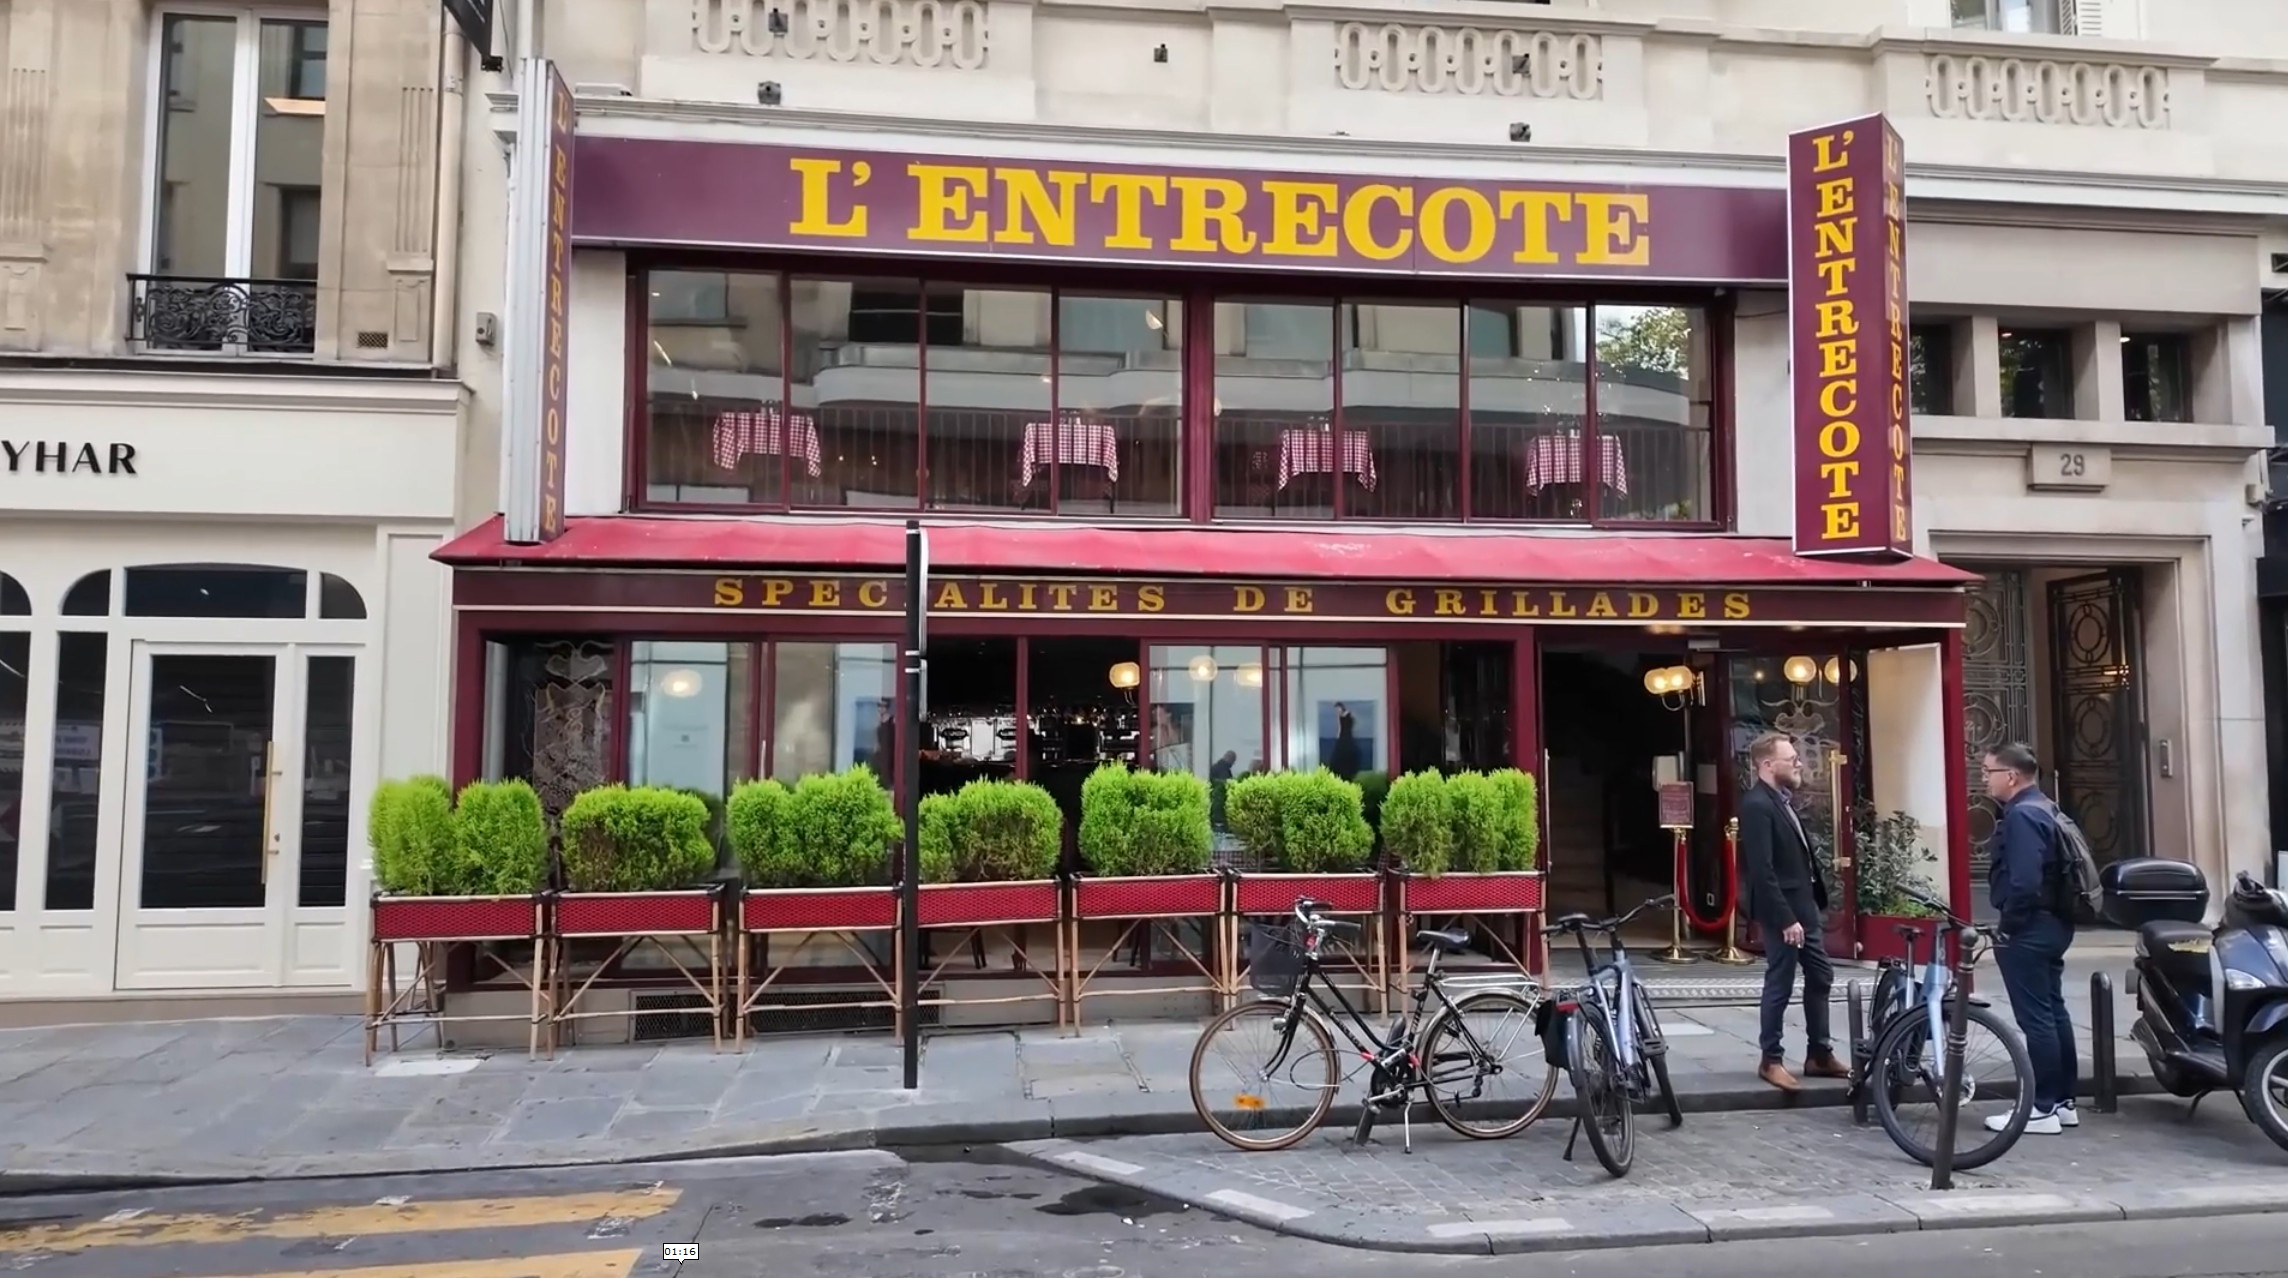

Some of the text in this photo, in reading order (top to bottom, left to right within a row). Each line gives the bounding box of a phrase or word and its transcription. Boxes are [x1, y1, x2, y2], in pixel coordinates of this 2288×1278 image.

[907, 163, 1650, 266] ENTRECOTE
[1812, 130, 1860, 540] L'ENTRECOTE
[1, 439, 138, 474] YHAR
[2060, 453, 2085, 477] 29
[714, 578, 1750, 618] SPECALITES DE GRILLADES
